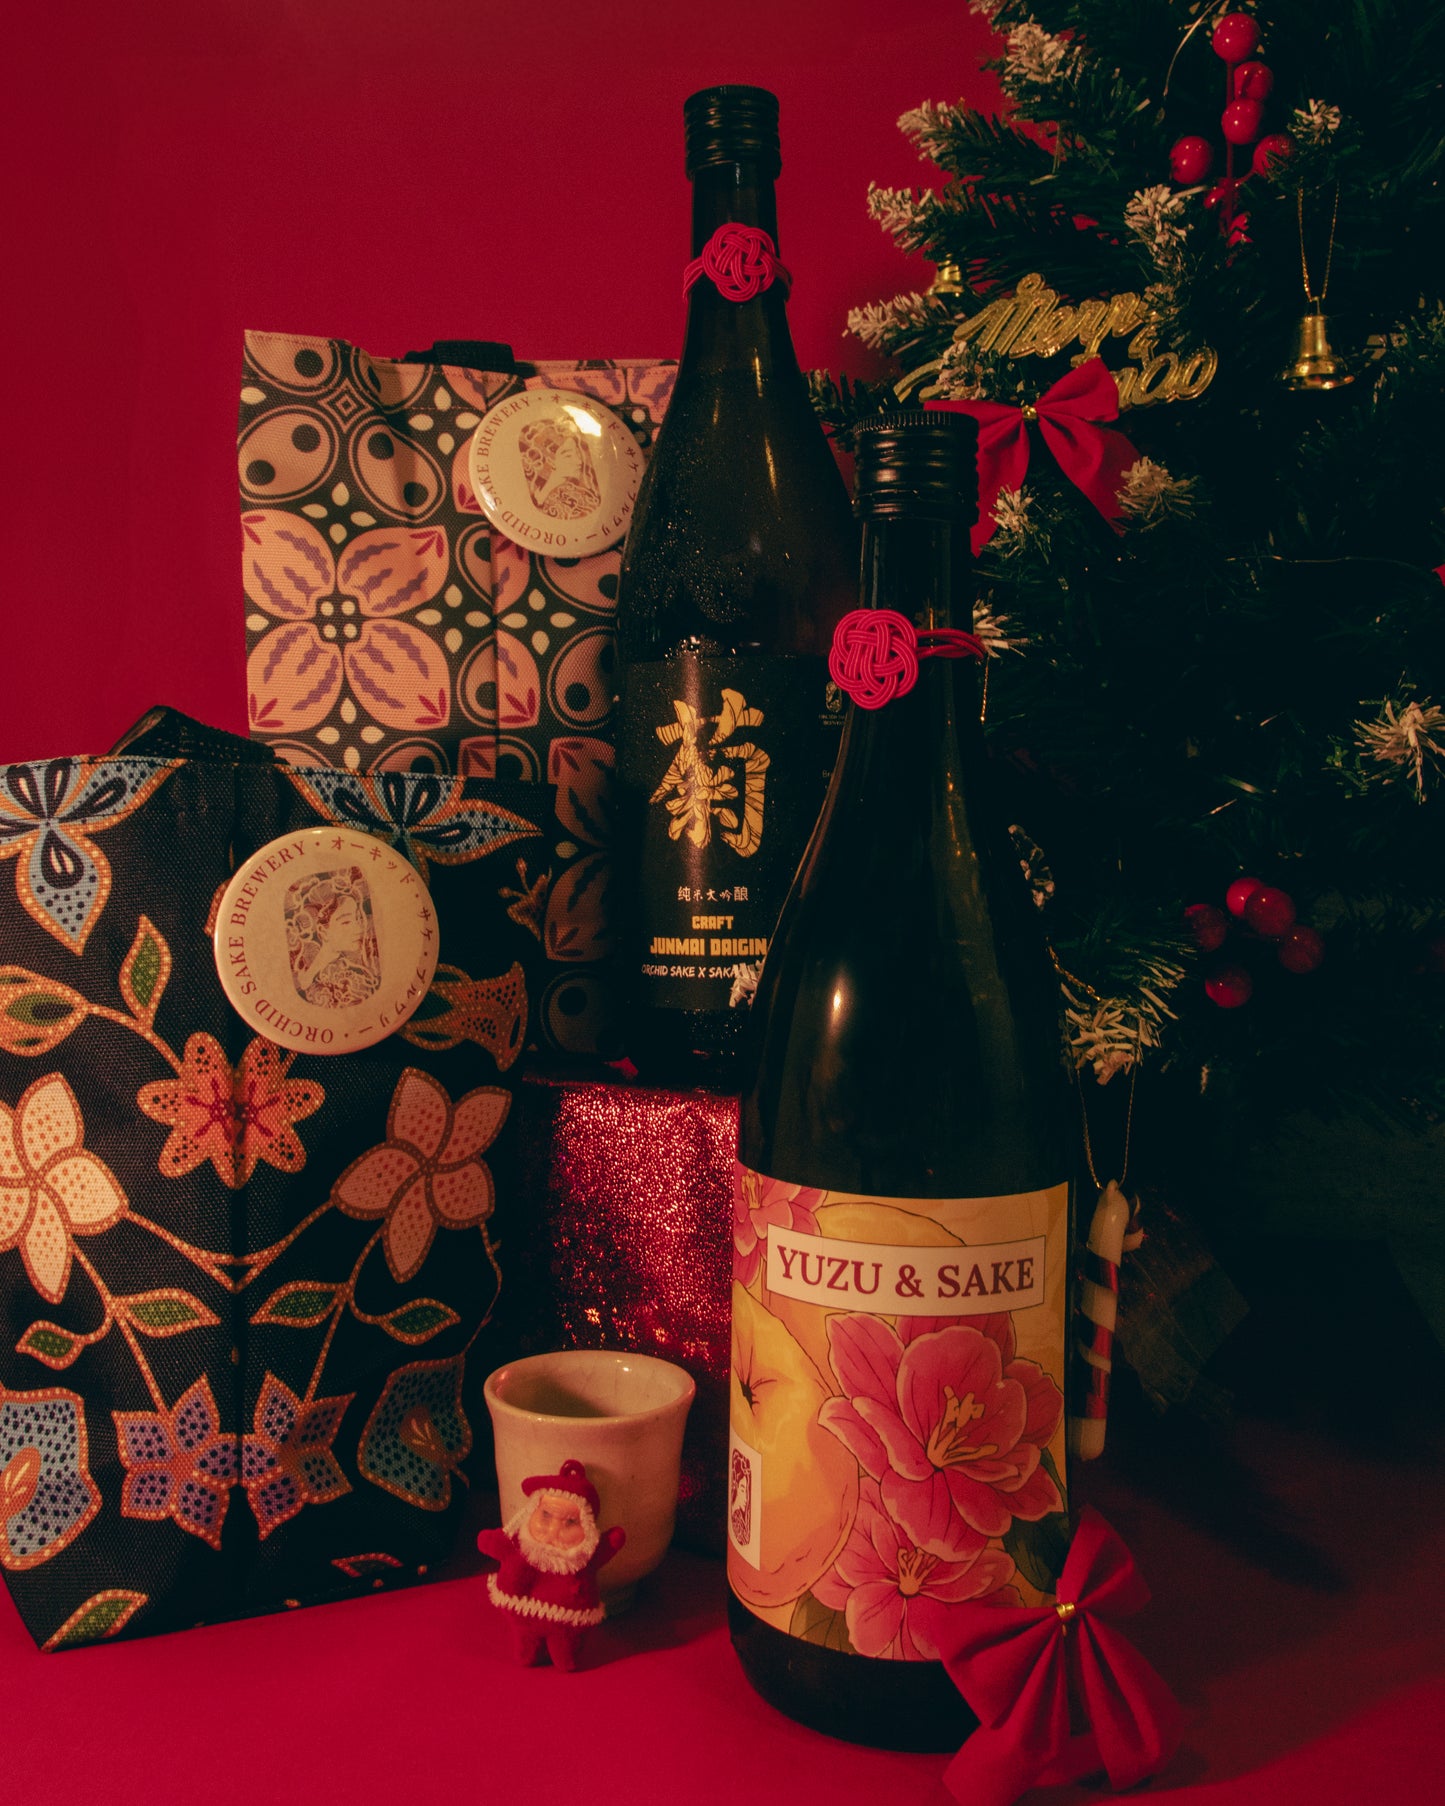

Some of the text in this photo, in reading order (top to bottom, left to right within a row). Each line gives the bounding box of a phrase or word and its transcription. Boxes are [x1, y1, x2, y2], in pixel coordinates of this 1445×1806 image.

[476, 396, 567, 546] ORCHID SAKE BREWERY
[648, 687, 772, 858] 菊
[228, 840, 334, 1044] ORCHID SAKE BREWERY
[650, 936, 768, 957] JUNMAI DAIGIN
[691, 915, 735, 930] CRAFT
[641, 963, 738, 980] ORCHID SAKE X SAKA
[777, 1244, 1034, 1299] YUZU & SAKE
